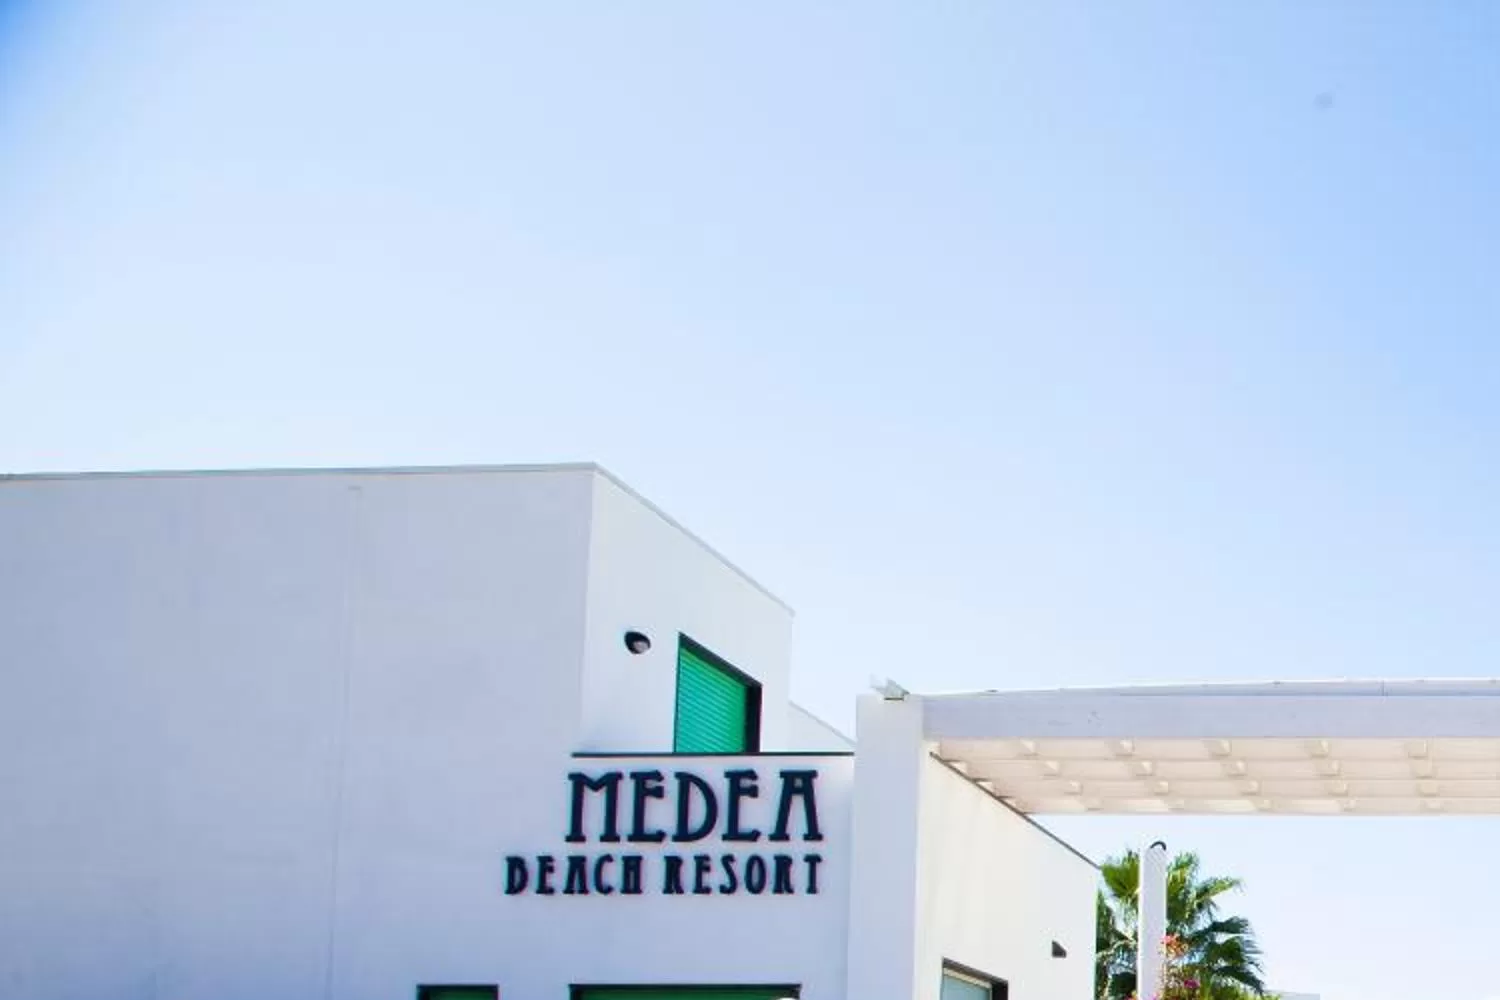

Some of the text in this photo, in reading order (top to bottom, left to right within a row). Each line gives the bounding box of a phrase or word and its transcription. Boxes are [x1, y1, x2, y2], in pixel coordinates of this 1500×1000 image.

[565, 769, 824, 843] MEDEA
[504, 854, 823, 895] BEACH RESORT
